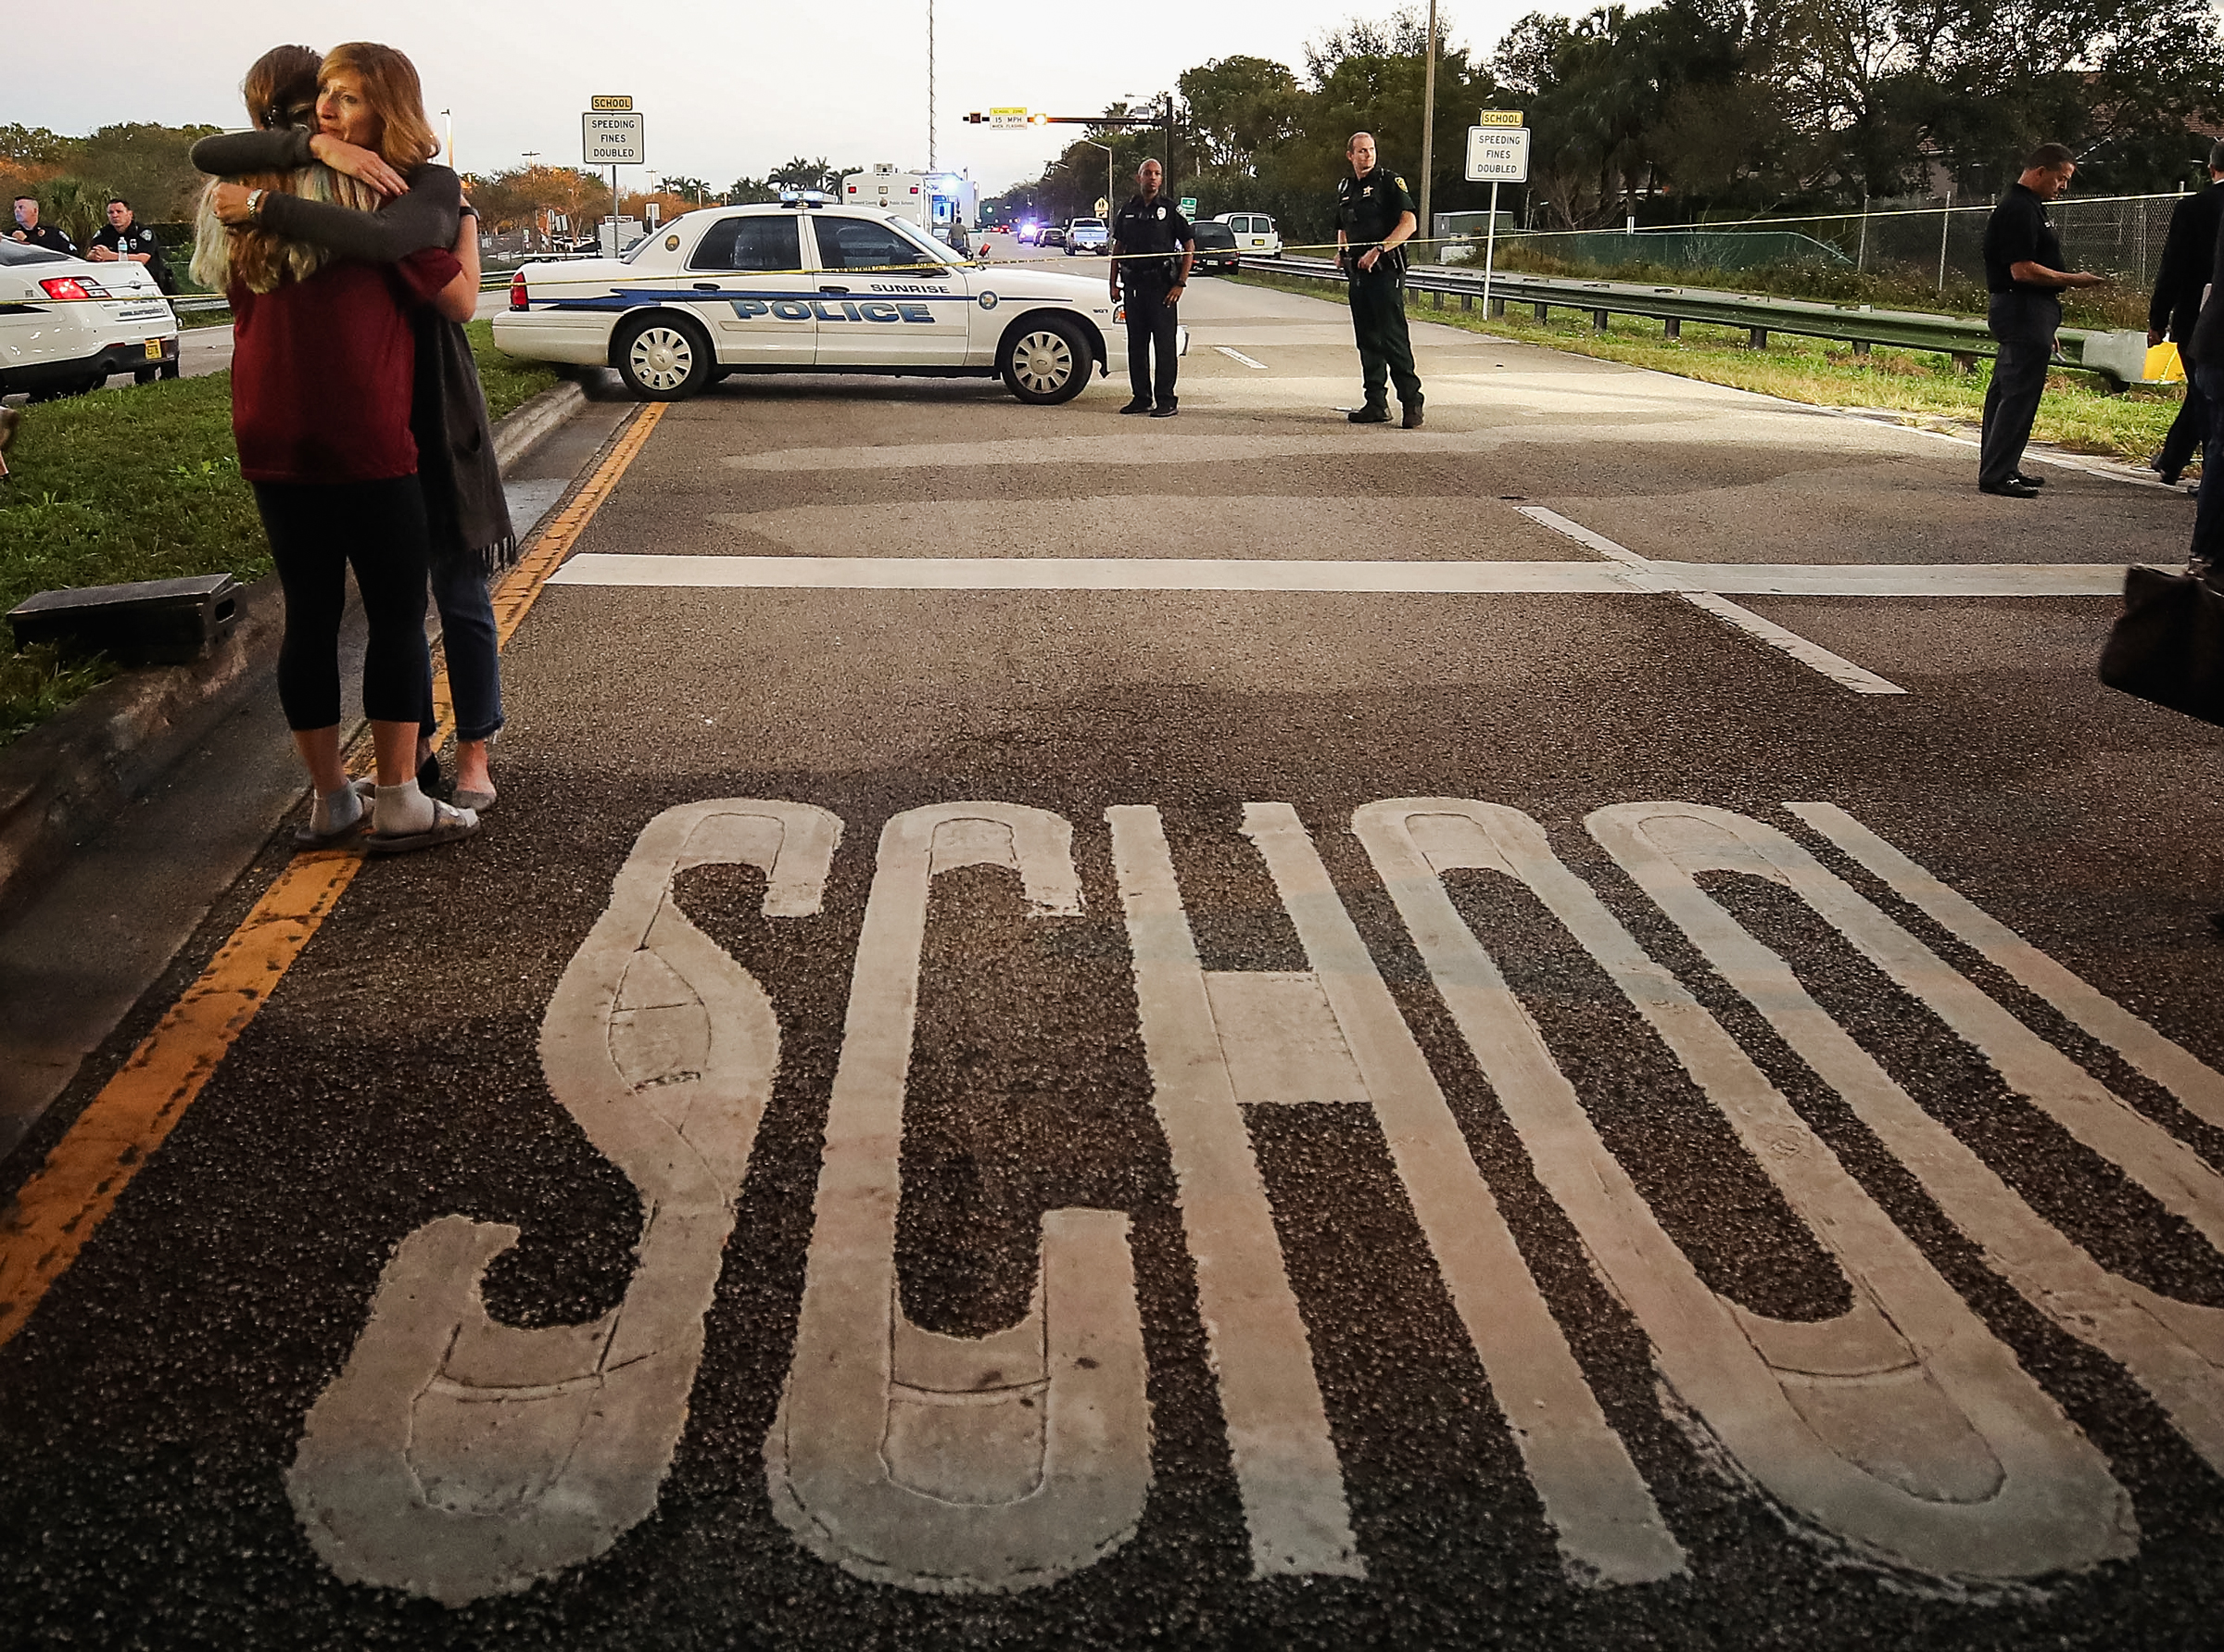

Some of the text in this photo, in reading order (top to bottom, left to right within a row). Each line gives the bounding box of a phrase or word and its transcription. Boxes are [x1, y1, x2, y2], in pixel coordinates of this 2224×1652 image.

[594, 98, 630, 107] SCHOOL
[1484, 114, 1520, 123] SCHOOL
[591, 120, 635, 129] SPEEDING
[600, 134, 626, 143] FINES
[1478, 135, 1521, 145] SPEEDING
[593, 148, 634, 158] DOUBLED
[1485, 149, 1511, 158] FINES
[1477, 164, 1517, 173] DOUBLED
[870, 284, 951, 294] SUNRISE
[729, 299, 935, 323] POLICE
